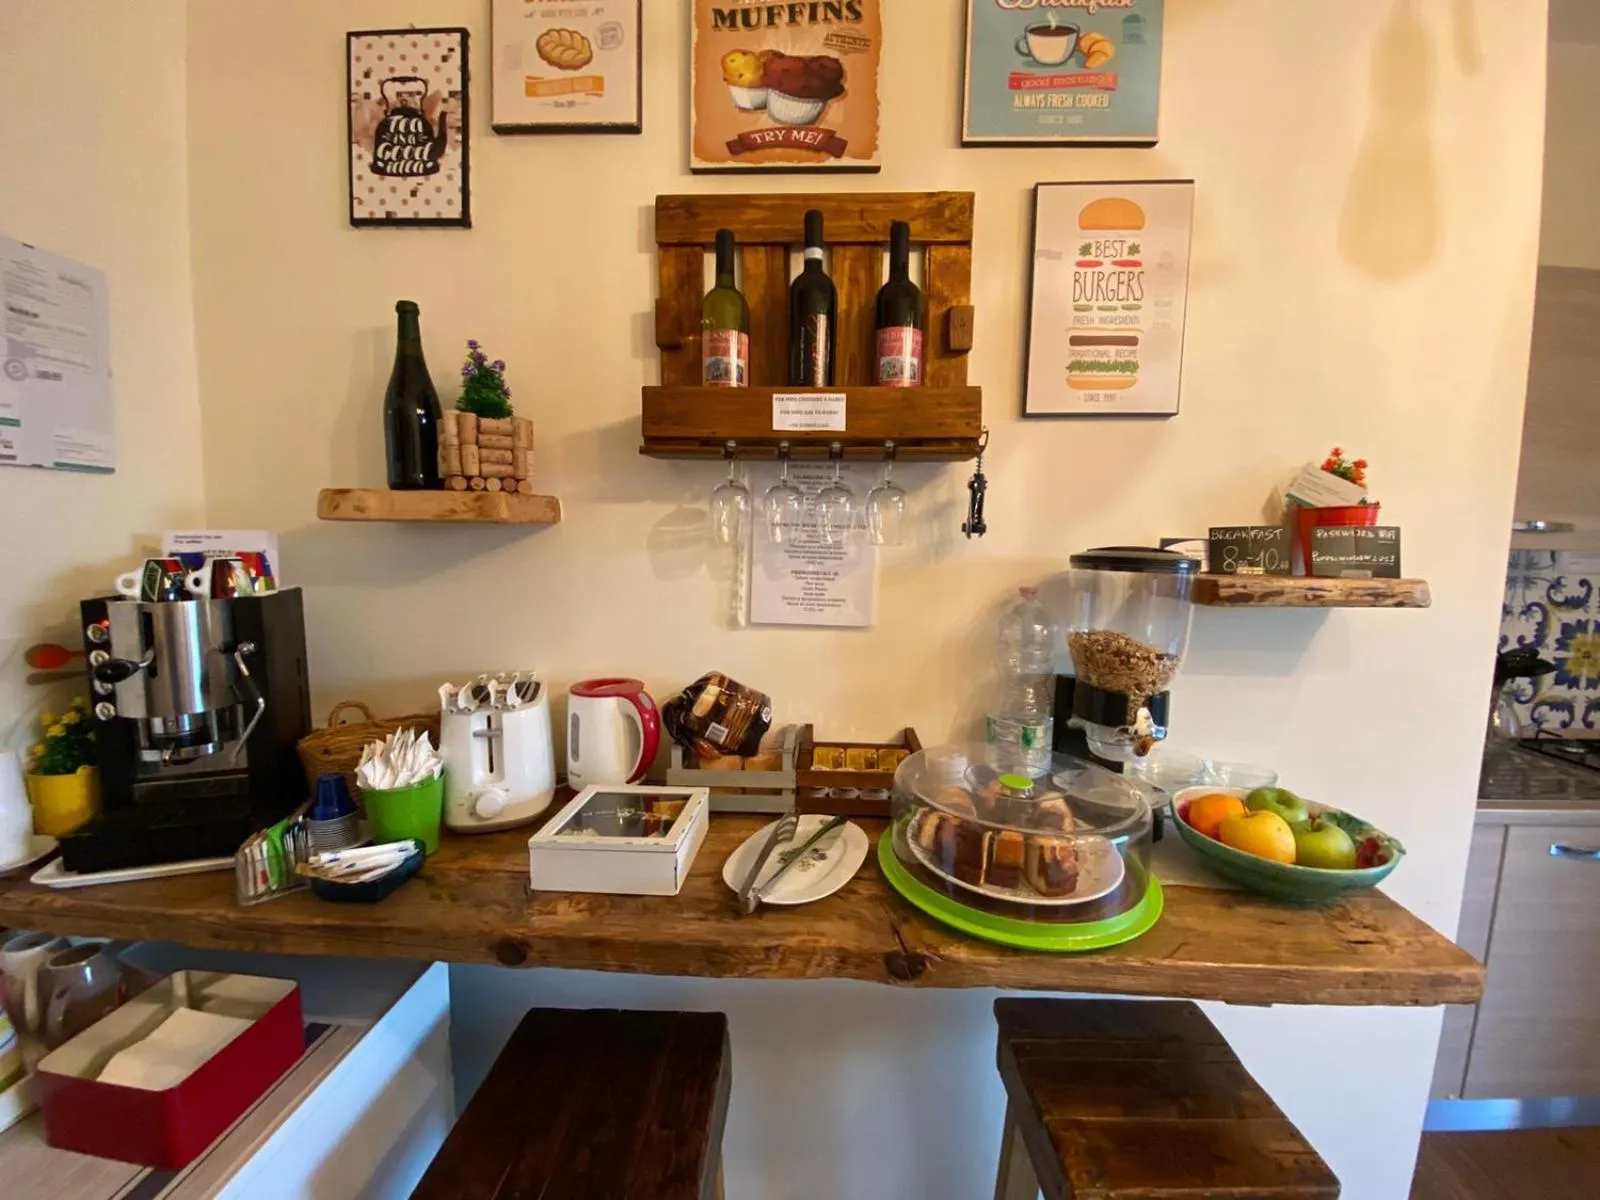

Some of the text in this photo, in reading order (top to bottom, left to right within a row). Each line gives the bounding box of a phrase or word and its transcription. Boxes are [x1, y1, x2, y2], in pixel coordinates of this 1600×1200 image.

[711, 0, 865, 30] MUFFINS
[1014, 93, 1110, 108] ALWAYS FRESH COOKED
[750, 129, 824, 145] TRY ME!
[1094, 239, 1126, 258] BEST
[1072, 271, 1145, 303] BURGERS
[1211, 528, 1283, 541] BREAKFAST
